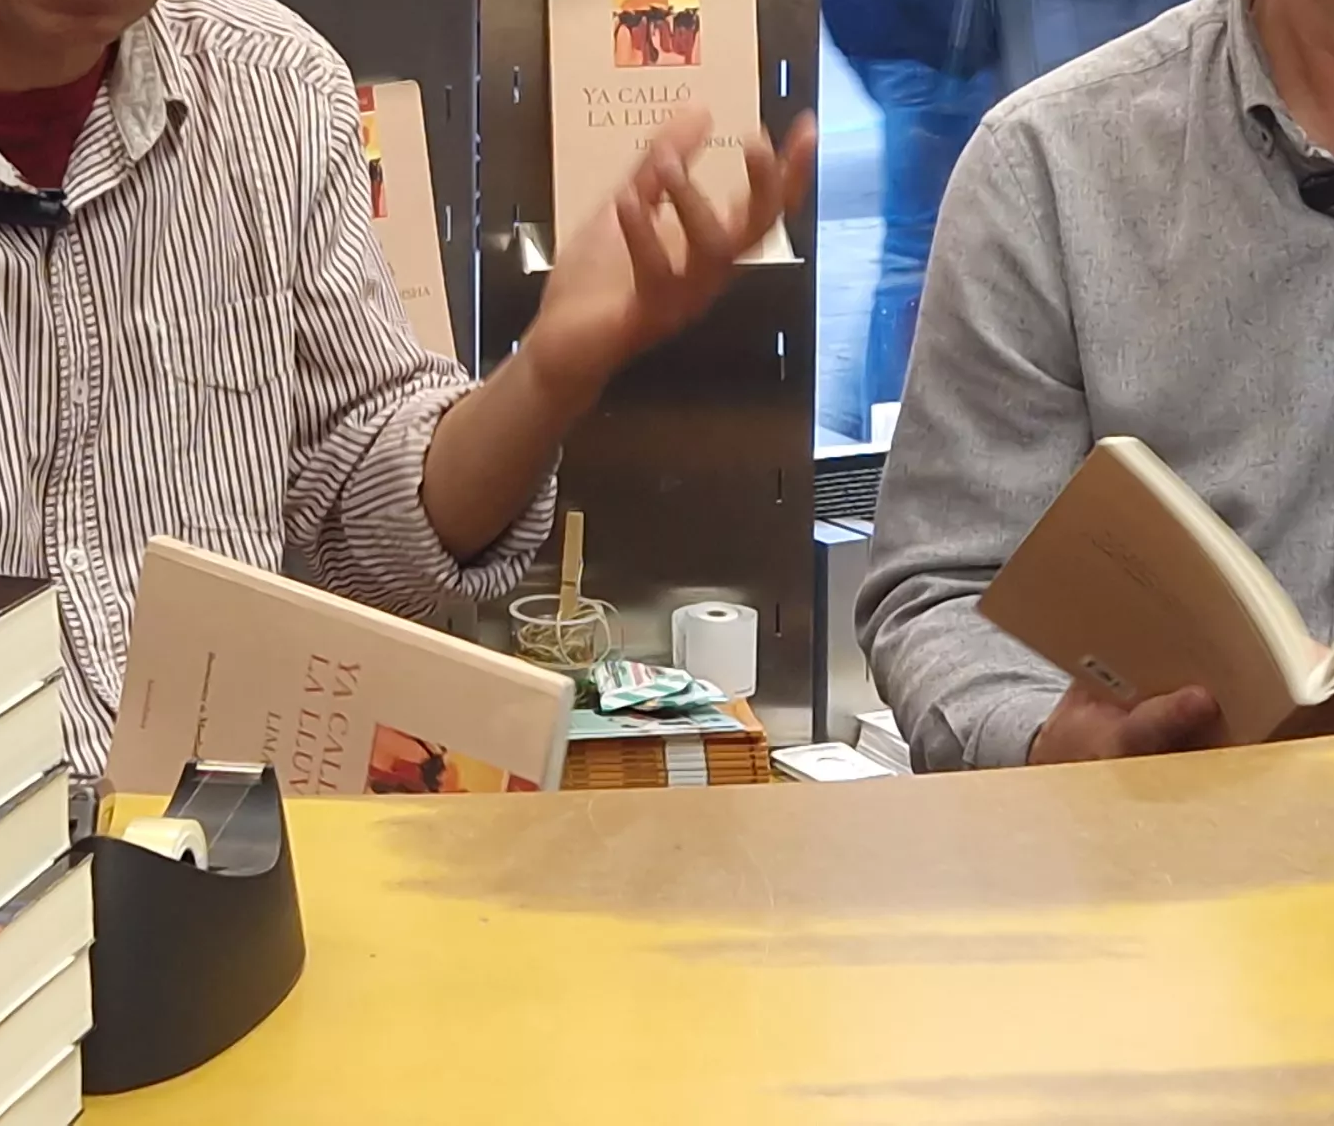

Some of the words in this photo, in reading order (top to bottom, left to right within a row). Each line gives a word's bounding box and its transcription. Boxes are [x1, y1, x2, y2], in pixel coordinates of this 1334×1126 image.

[582, 87, 611, 105] YA
[618, 83, 691, 104] CALLÓ
[587, 110, 616, 127] LA
[304, 653, 331, 694] LA
[332, 659, 361, 698] YA
[260, 710, 282, 764] LIMA
[289, 708, 321, 795] LLUV
[316, 711, 349, 795] CALL
